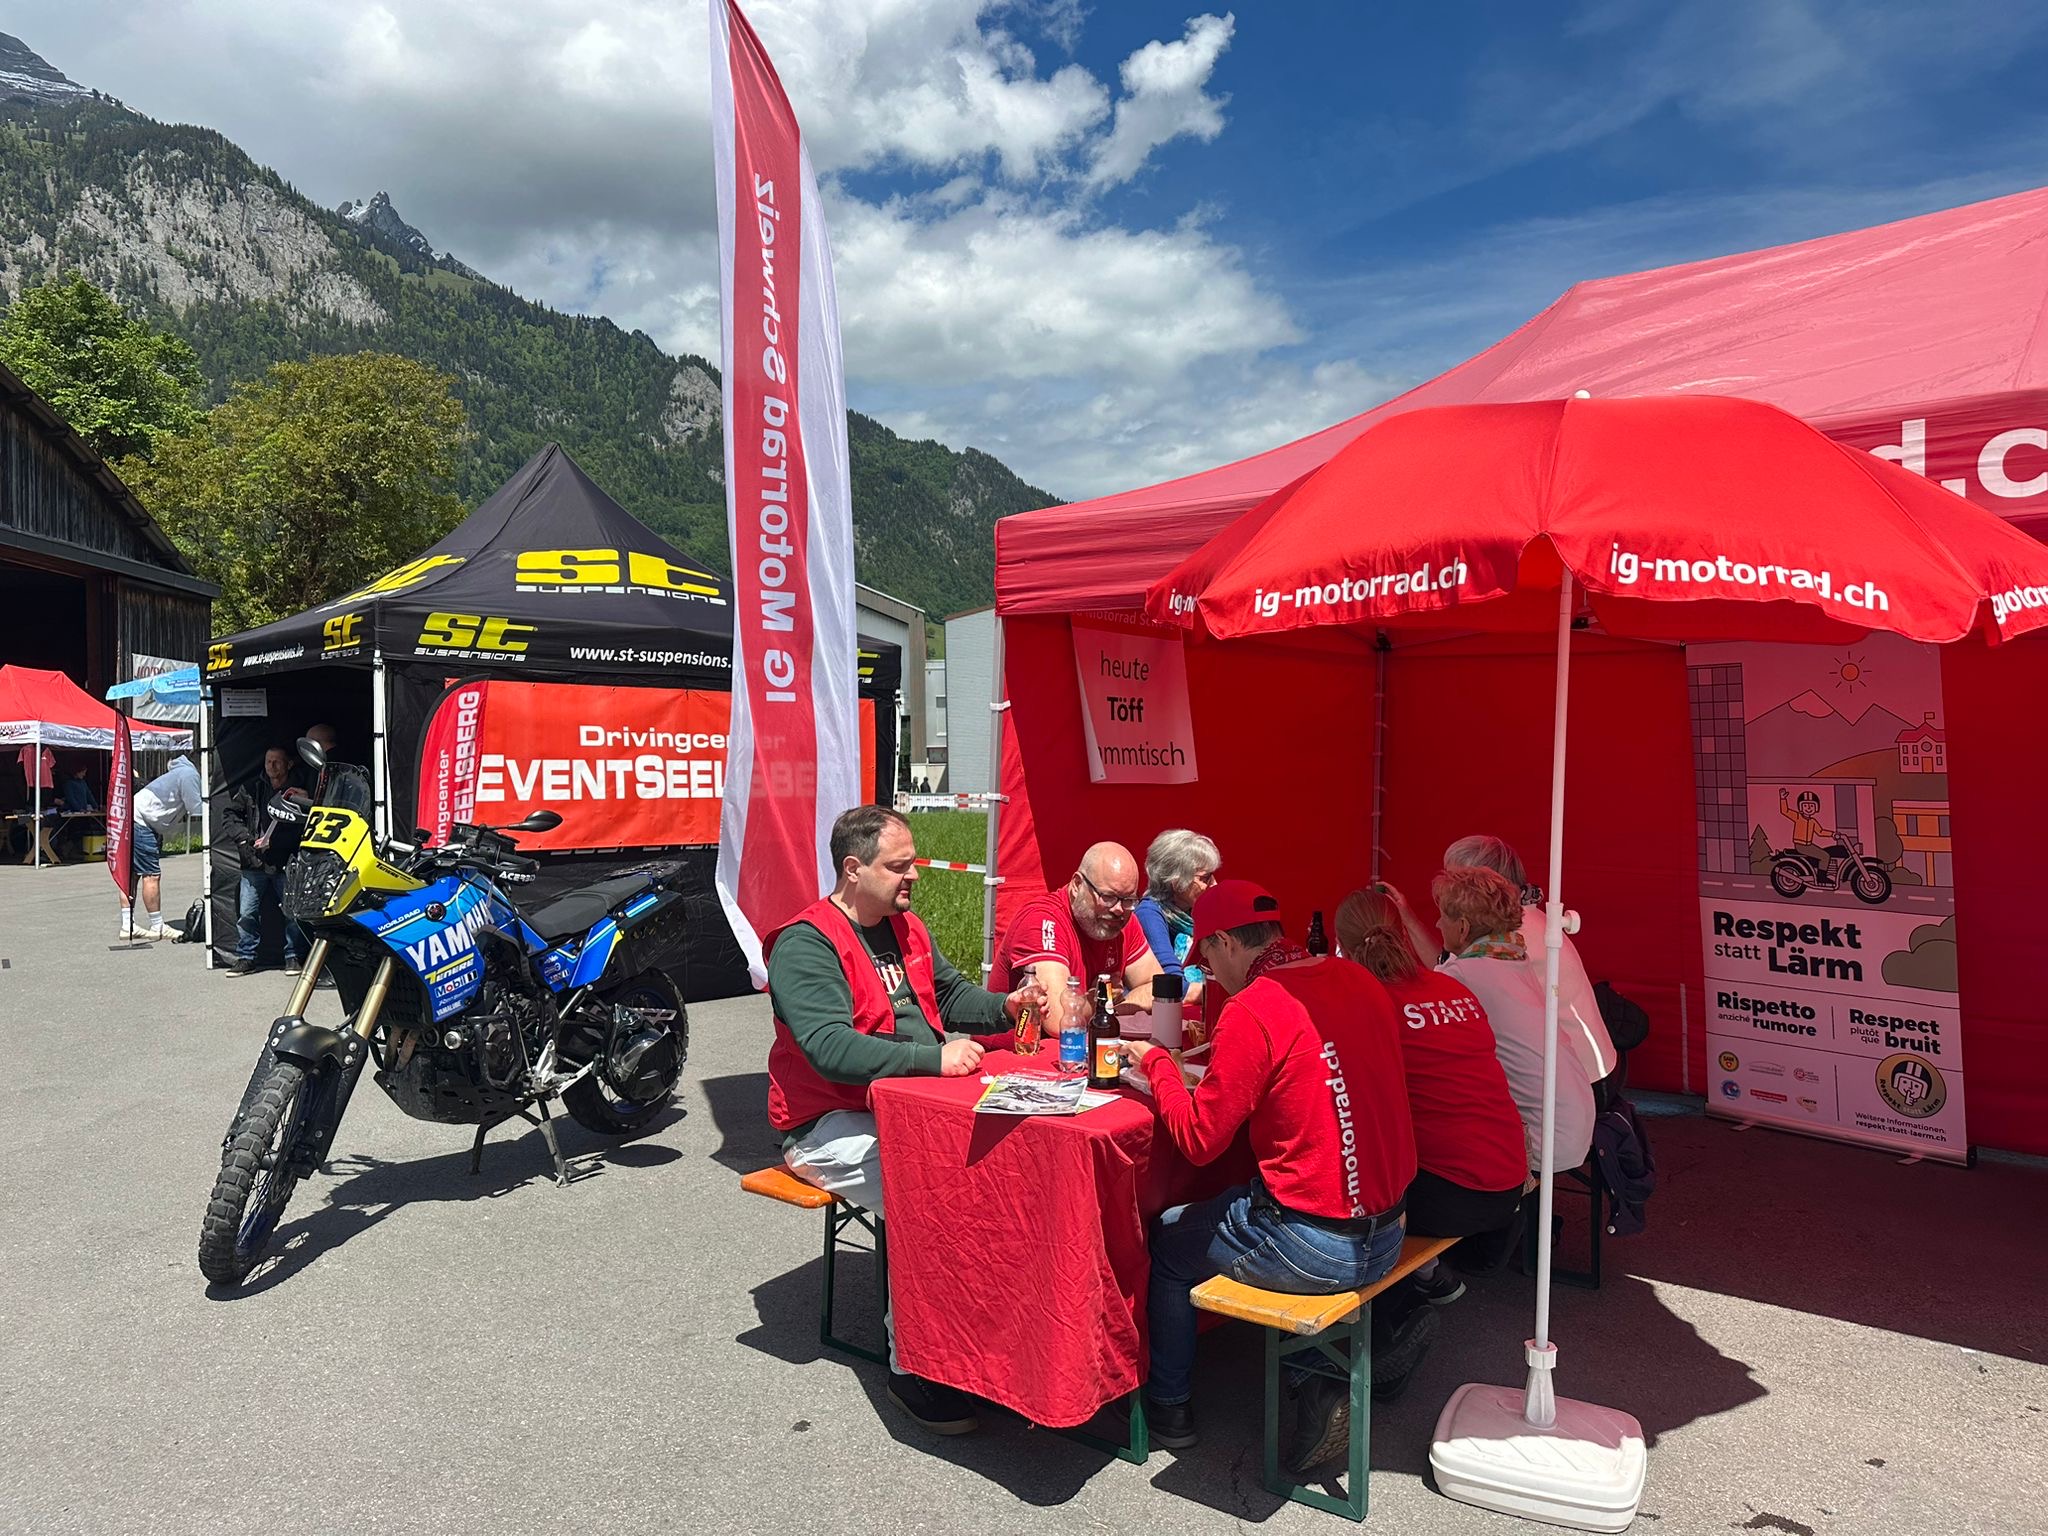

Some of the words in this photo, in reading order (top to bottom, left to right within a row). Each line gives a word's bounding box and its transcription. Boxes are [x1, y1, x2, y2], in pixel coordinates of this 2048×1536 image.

[1253, 556, 1469, 618] ig-motorrad.ch
[1609, 541, 1889, 612] ig-motorrad.ch
[570, 646, 733, 669] www.st-suspensions.
[1100, 651, 1150, 682] heute
[1107, 696, 1144, 722] Töff
[453, 690, 481, 825] EELISBERG
[267, 804, 297, 822] CERBIS
[434, 749, 451, 848] vingcenter
[377, 917, 405, 932] WORLD
[403, 908, 421, 921] RAID
[405, 898, 495, 972] YAMAHA
[1712, 910, 1862, 949] Respekt
[1713, 942, 1762, 961] statt
[1768, 946, 1863, 982] Lärm
[435, 975, 466, 998] Mobil
[1403, 997, 1481, 1029] STAFF
[1716, 991, 1816, 1020] Rispetto
[1717, 1011, 1751, 1024] anziché
[1752, 1017, 1817, 1037] rumore
[1849, 1008, 1941, 1036] Respect
[1850, 1025, 1880, 1038] plutôt
[1884, 1031, 1942, 1055] bruit
[1860, 1034, 1880, 1045] que
[1879, 1078, 1901, 1109] Respekt
[1922, 1098, 1942, 1114] Lärm
[1319, 1041, 1366, 1218] g-motorrad.ch
[1855, 1111, 1886, 1123] Weitere
[1855, 1120, 1947, 1142] respekt-statt-laerm.ch
